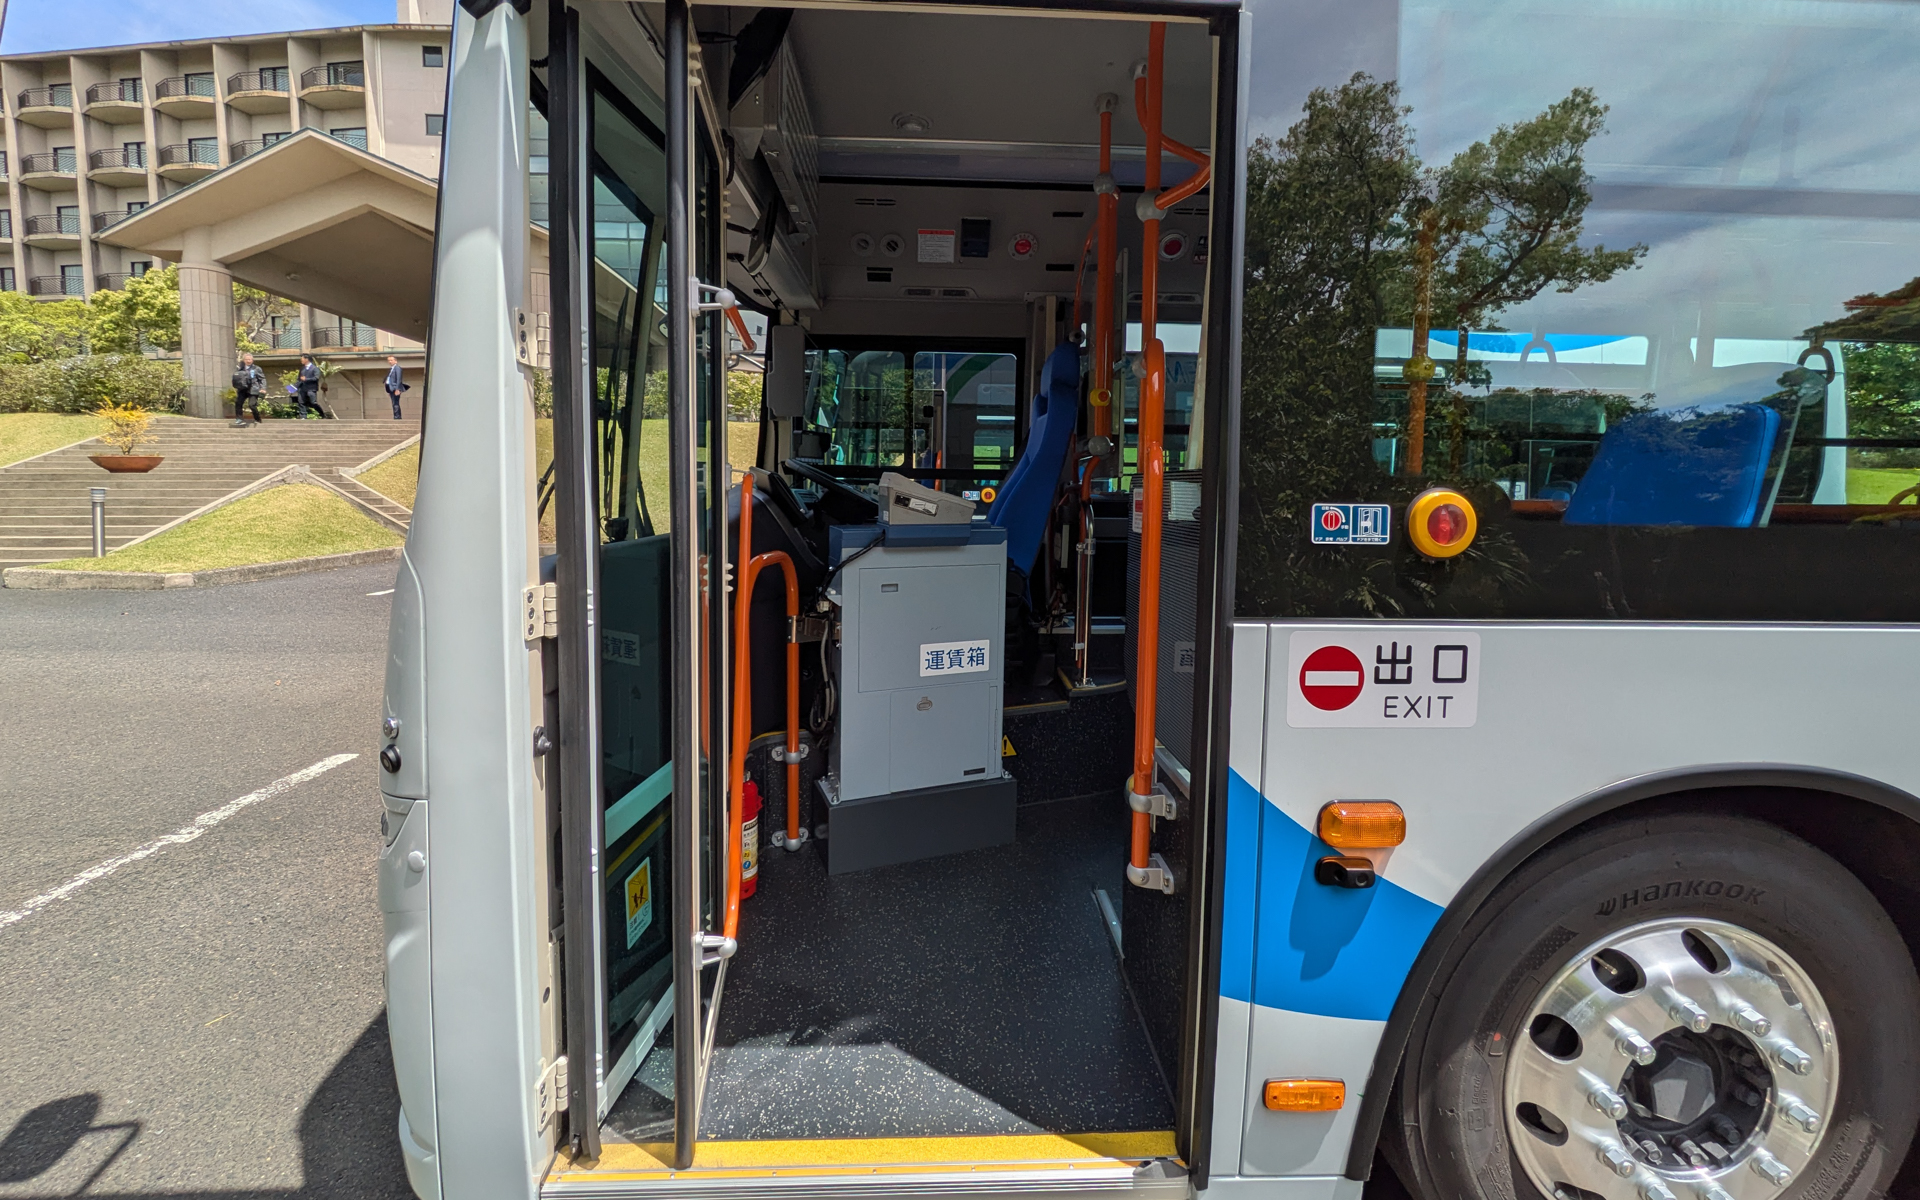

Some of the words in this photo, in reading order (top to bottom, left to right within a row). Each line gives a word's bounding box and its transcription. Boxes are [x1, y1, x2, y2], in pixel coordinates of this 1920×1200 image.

[924, 646, 986, 671] 運賃箱
[1374, 641, 1468, 685] 出口
[1383, 695, 1454, 719] EXIT
